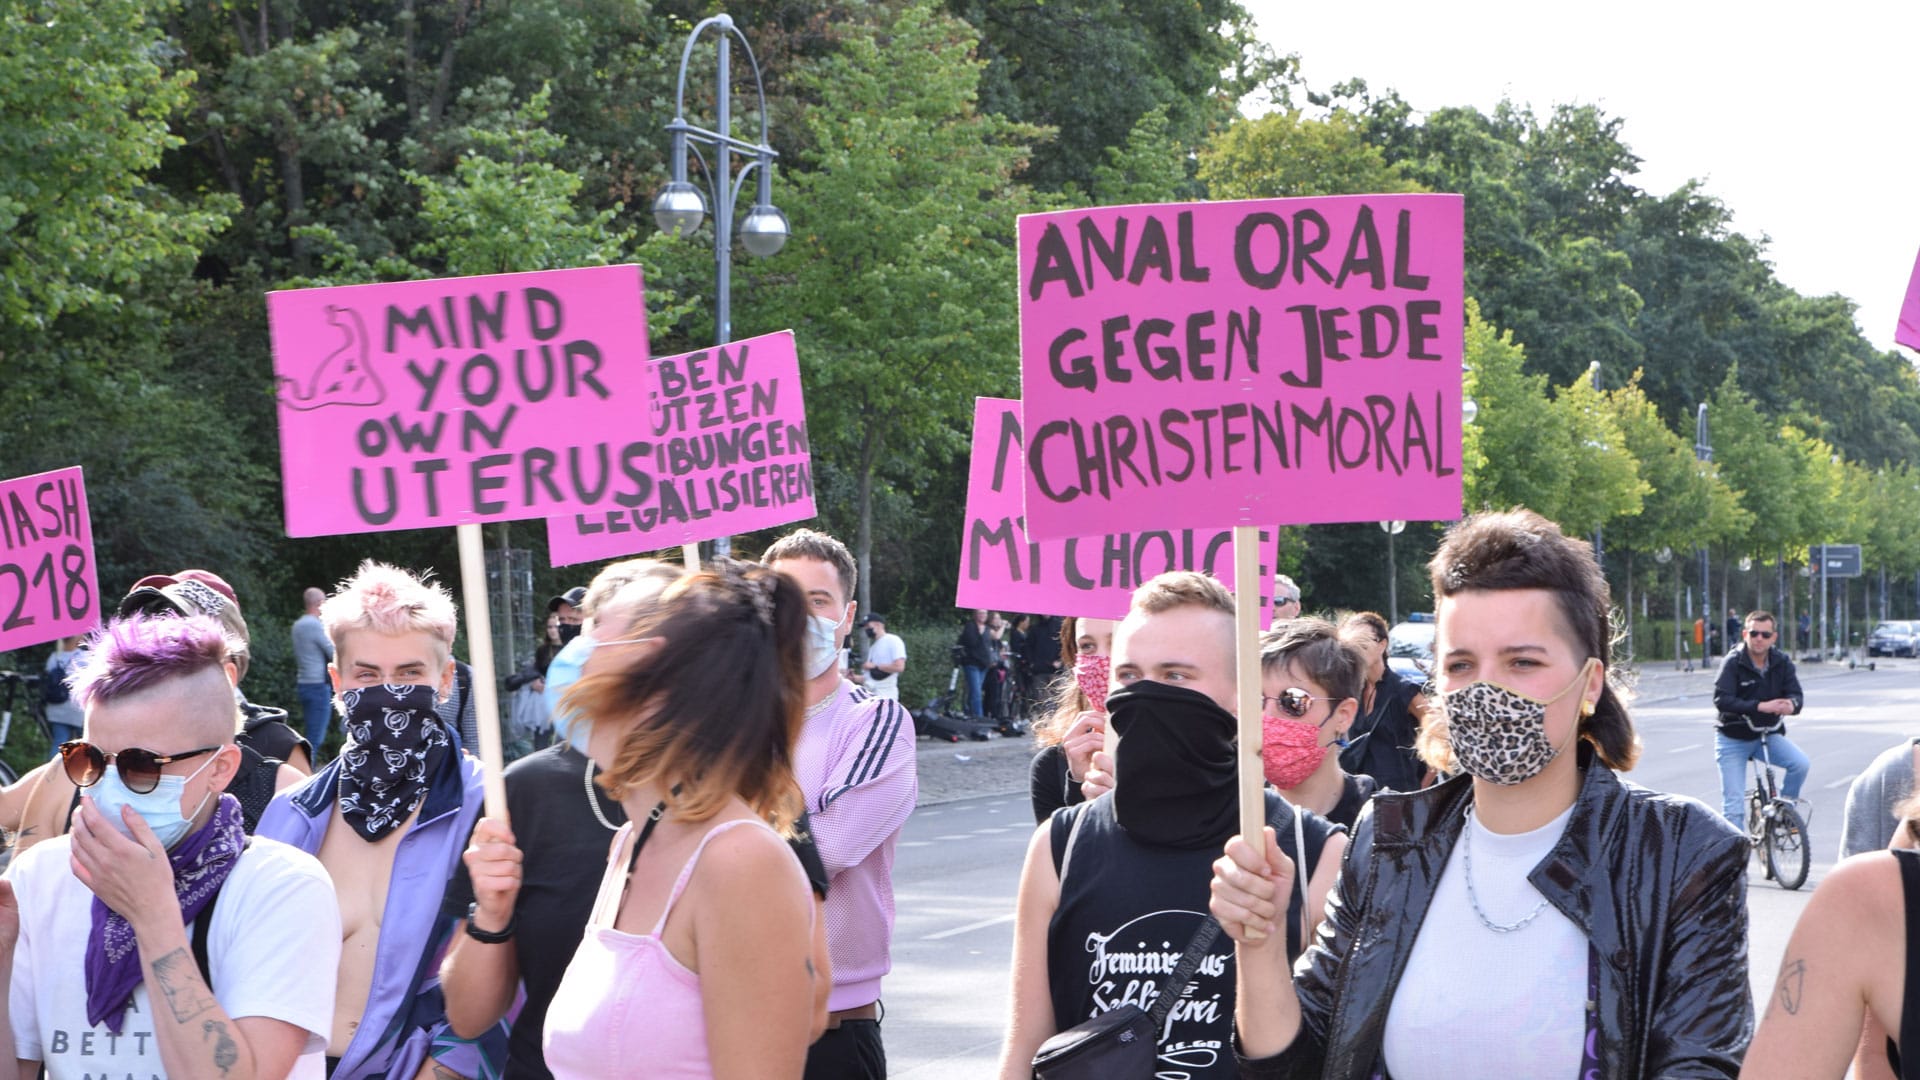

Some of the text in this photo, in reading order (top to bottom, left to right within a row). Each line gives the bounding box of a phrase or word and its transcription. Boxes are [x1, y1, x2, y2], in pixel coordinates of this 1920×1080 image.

[1029, 204, 1430, 301] ANAL ORAL
[383, 287, 562, 352] MIND
[1048, 300, 1442, 393] GEGEN JEDE
[405, 340, 611, 411] YOUR
[646, 345, 749, 398] BEN
[357, 403, 519, 457] OWN
[1028, 390, 1456, 502] CHRISTENMORAL
[351, 441, 654, 525] UTERUS
